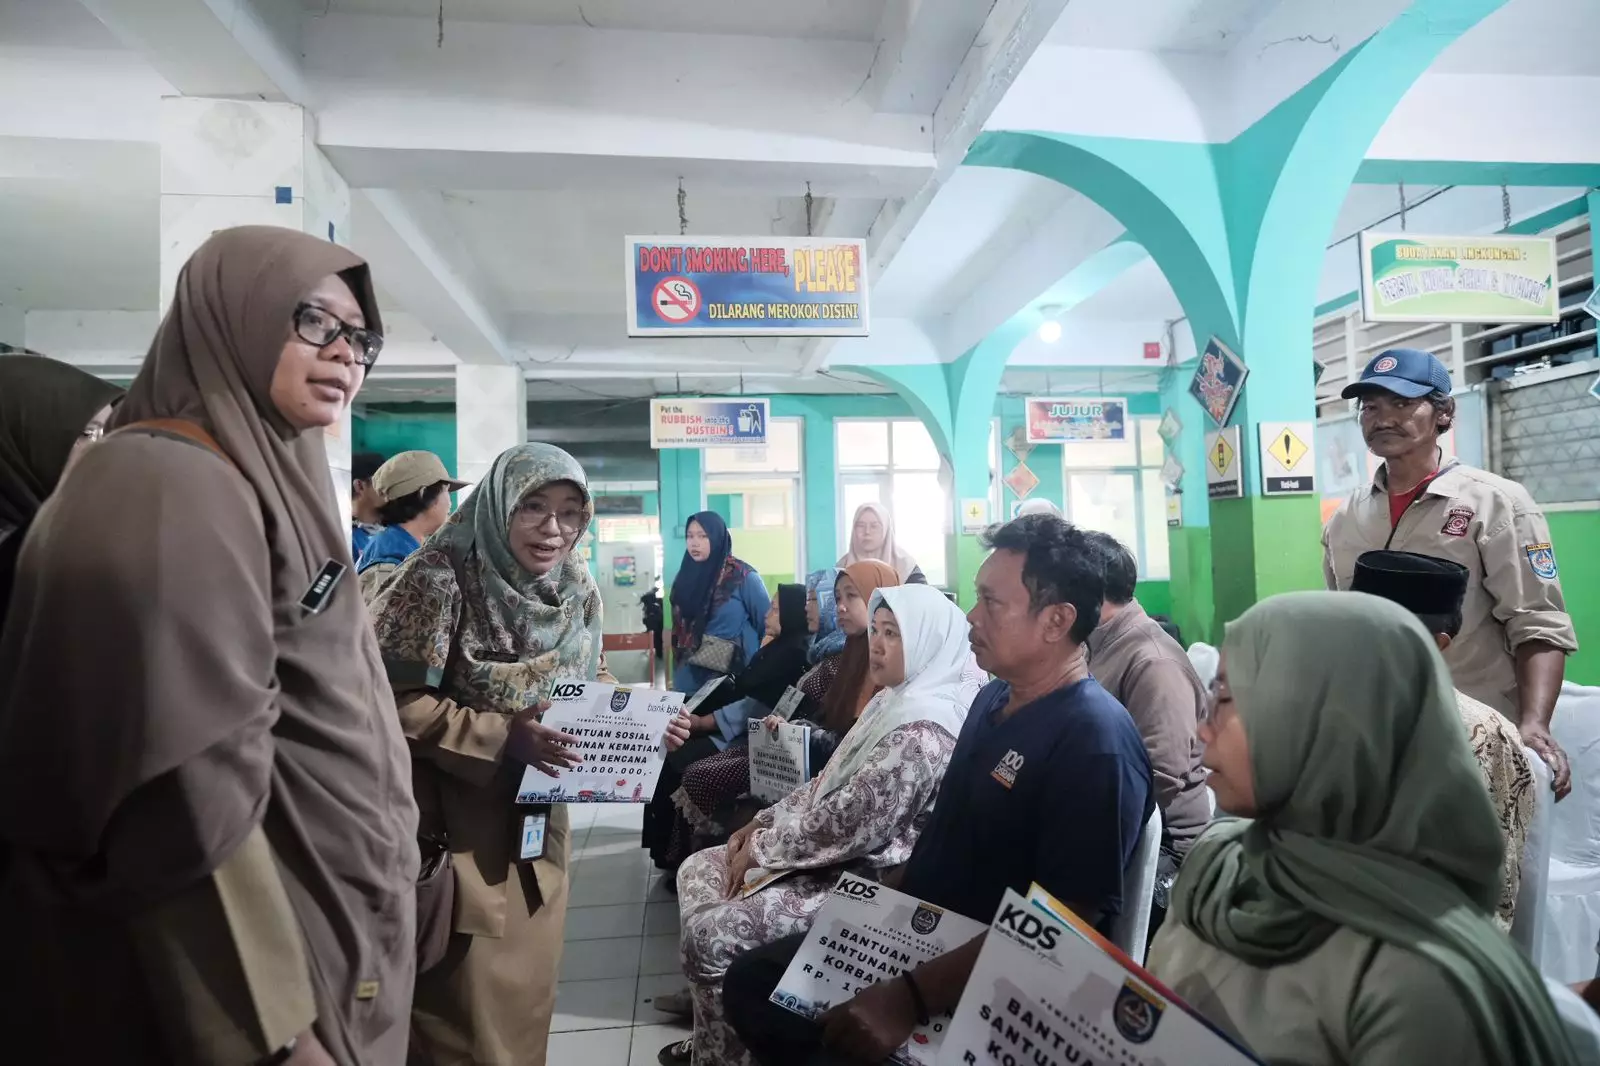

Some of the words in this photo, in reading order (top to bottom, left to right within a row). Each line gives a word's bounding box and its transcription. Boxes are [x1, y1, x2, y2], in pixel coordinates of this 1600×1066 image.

[639, 246, 683, 272] DON'T
[685, 247, 748, 273] SMOKING
[750, 248, 789, 278] HERE,
[793, 248, 857, 292] PLEASE
[709, 303, 765, 319] DILARANG
[767, 304, 819, 319] MEROKOK
[822, 304, 859, 319] DISINI
[660, 405, 671, 414] Put
[672, 405, 683, 413] the
[1049, 405, 1103, 417] JUJUR
[661, 415, 702, 424] RUBBISH
[552, 683, 586, 697] KDS
[647, 703, 665, 713] bank
[666, 704, 679, 716] bjb
[749, 721, 760, 730] KDS
[561, 727, 612, 738] BANTUAN
[615, 731, 650, 741] SOSIAL
[608, 742, 660, 753] KEMATIAN
[600, 754, 647, 764] BENCANA
[836, 878, 880, 899] KDS
[998, 903, 1061, 950] KDS
[839, 928, 911, 965] BANTUAN
[819, 936, 899, 976] SANTUNAN
[803, 963, 830, 982] Rp.
